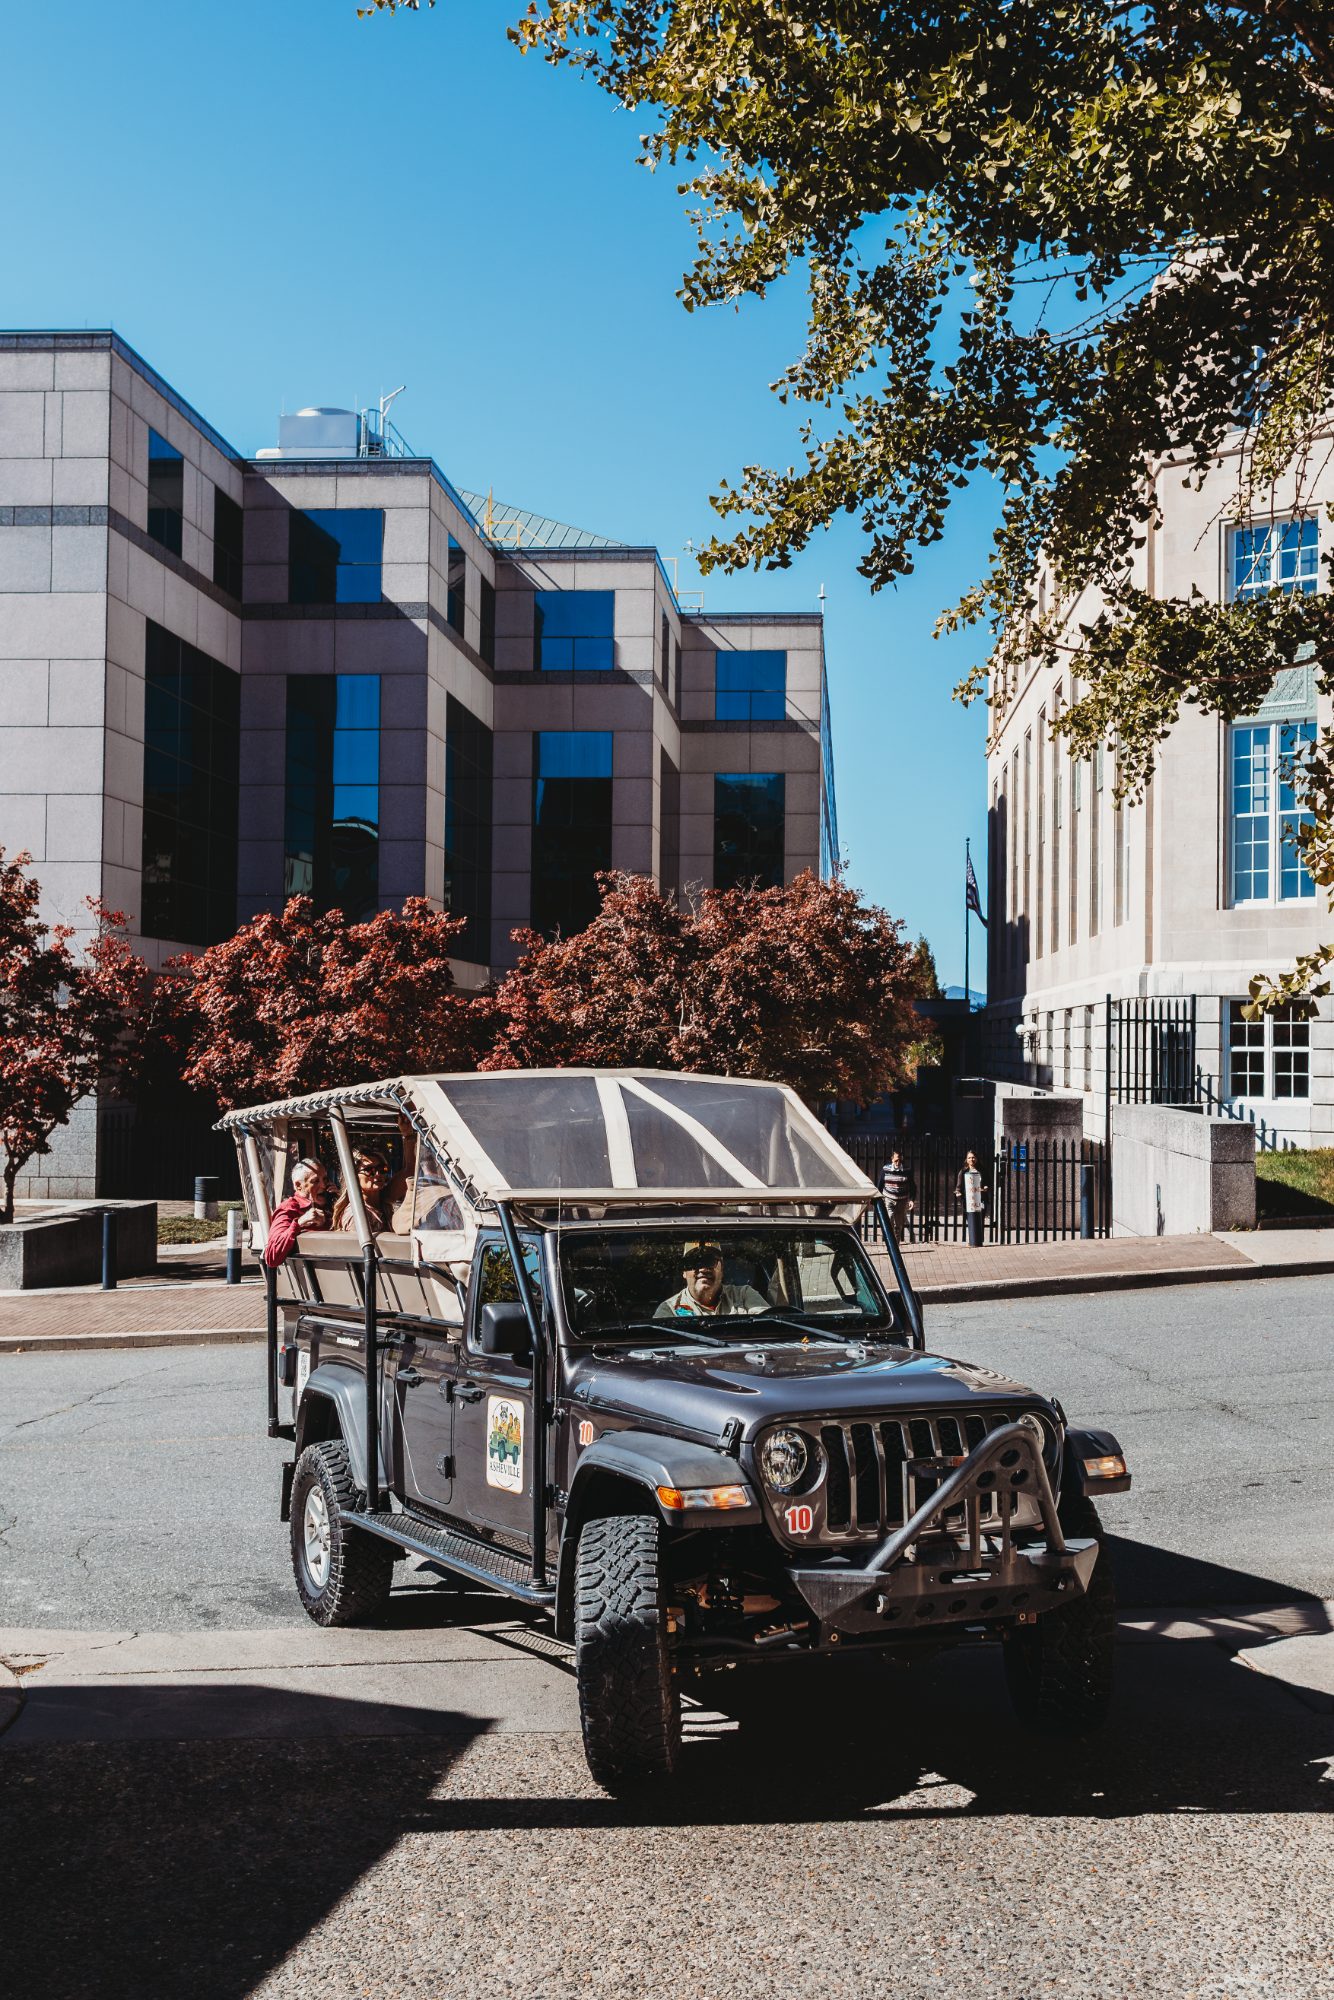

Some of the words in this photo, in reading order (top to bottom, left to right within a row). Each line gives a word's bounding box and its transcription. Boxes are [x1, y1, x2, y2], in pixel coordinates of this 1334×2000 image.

[580, 1421, 593, 1445] 10
[490, 1462, 520, 1478] ASHEVILLE
[786, 1506, 812, 1533] 10
